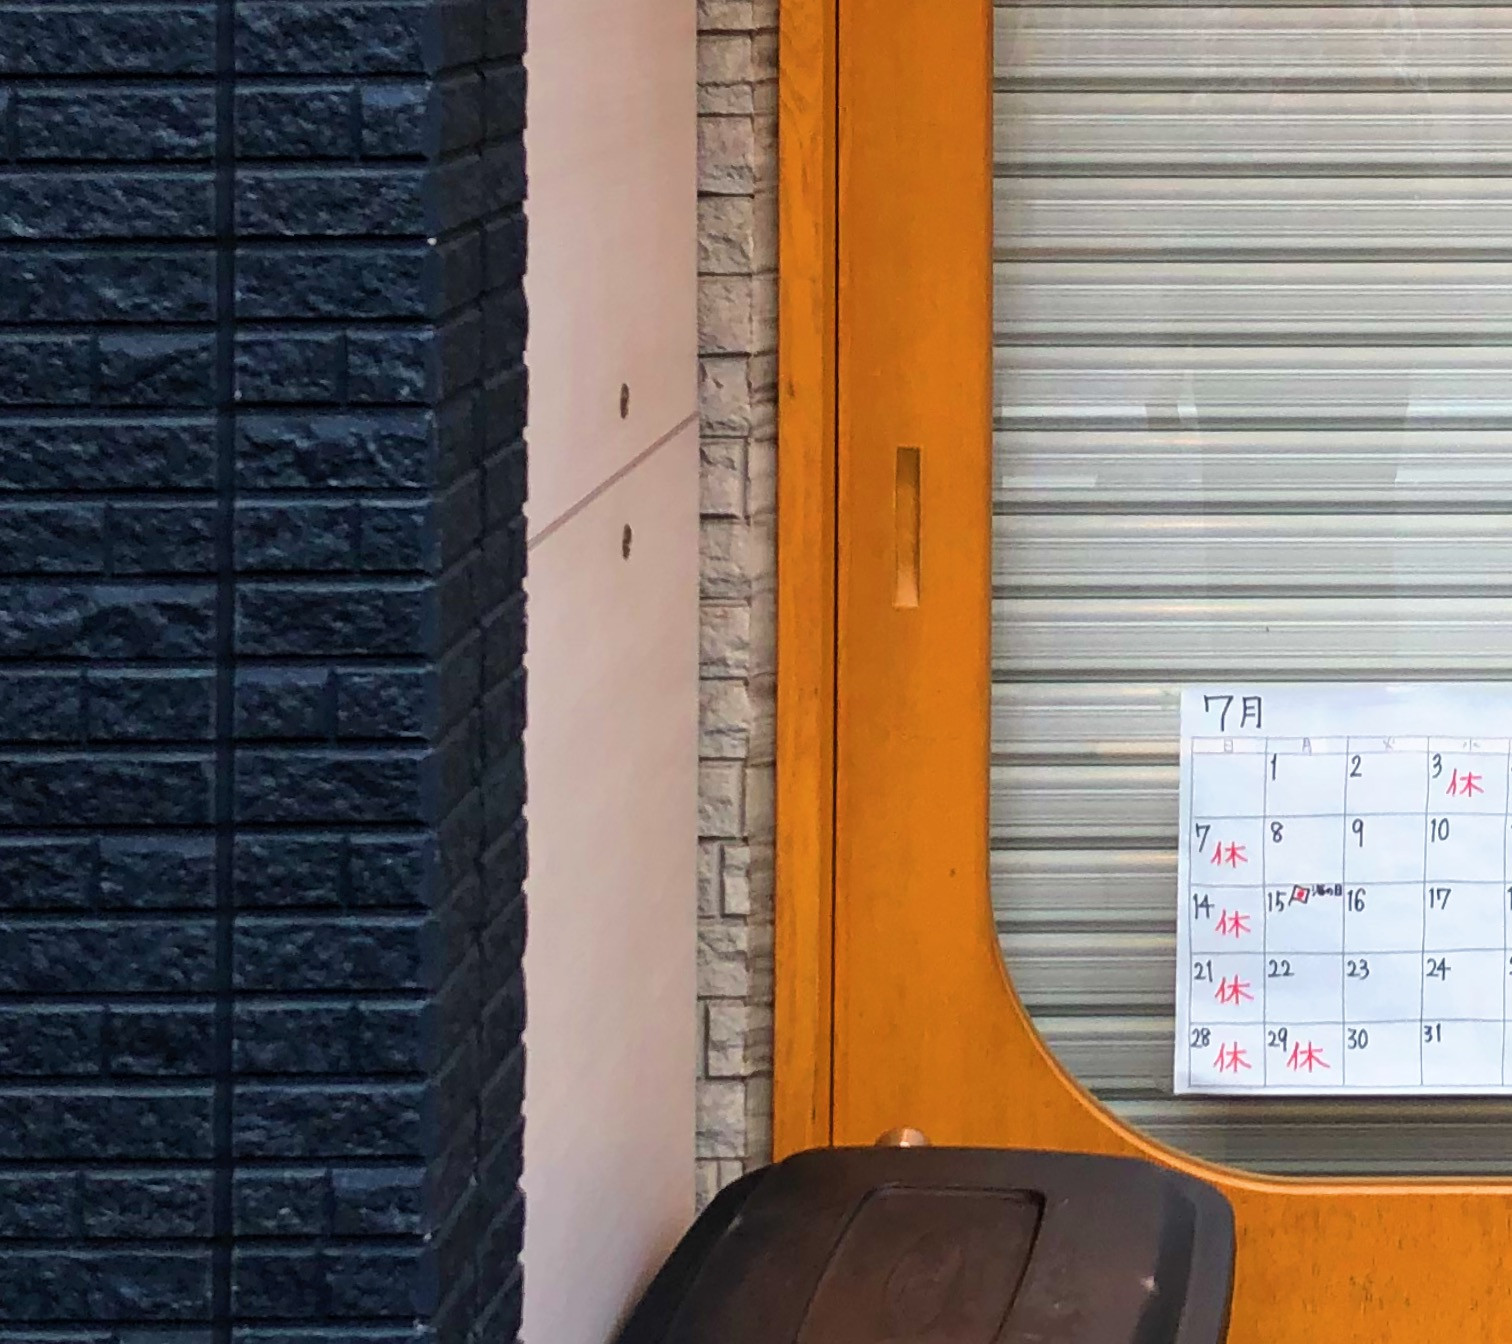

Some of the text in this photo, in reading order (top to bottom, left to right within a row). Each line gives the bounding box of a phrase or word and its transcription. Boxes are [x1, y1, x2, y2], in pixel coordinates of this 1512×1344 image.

[1204, 694, 1262, 732] 7月
[1270, 753, 1277, 780] 1
[1350, 755, 1362, 777] 2
[1432, 754, 1442, 778] 3
[1446, 768, 1484, 798] 休
[1196, 822, 1210, 852] 7
[1210, 841, 1248, 868] 休
[1270, 822, 1283, 842] 8
[1352, 818, 1364, 847] 9
[1431, 818, 1450, 842] 10
[1193, 894, 1214, 919] 14
[1215, 909, 1250, 938] 休
[1268, 892, 1287, 912] 15
[1347, 888, 1366, 912] 16
[1429, 888, 1451, 910] 17
[1194, 960, 1213, 982] 21
[1214, 974, 1254, 1005] 休
[1268, 960, 1294, 977] 22
[1347, 959, 1370, 980] 23
[1426, 957, 1451, 980] 24
[1190, 1024, 1441, 1073] 28 休 29 休 30 31
